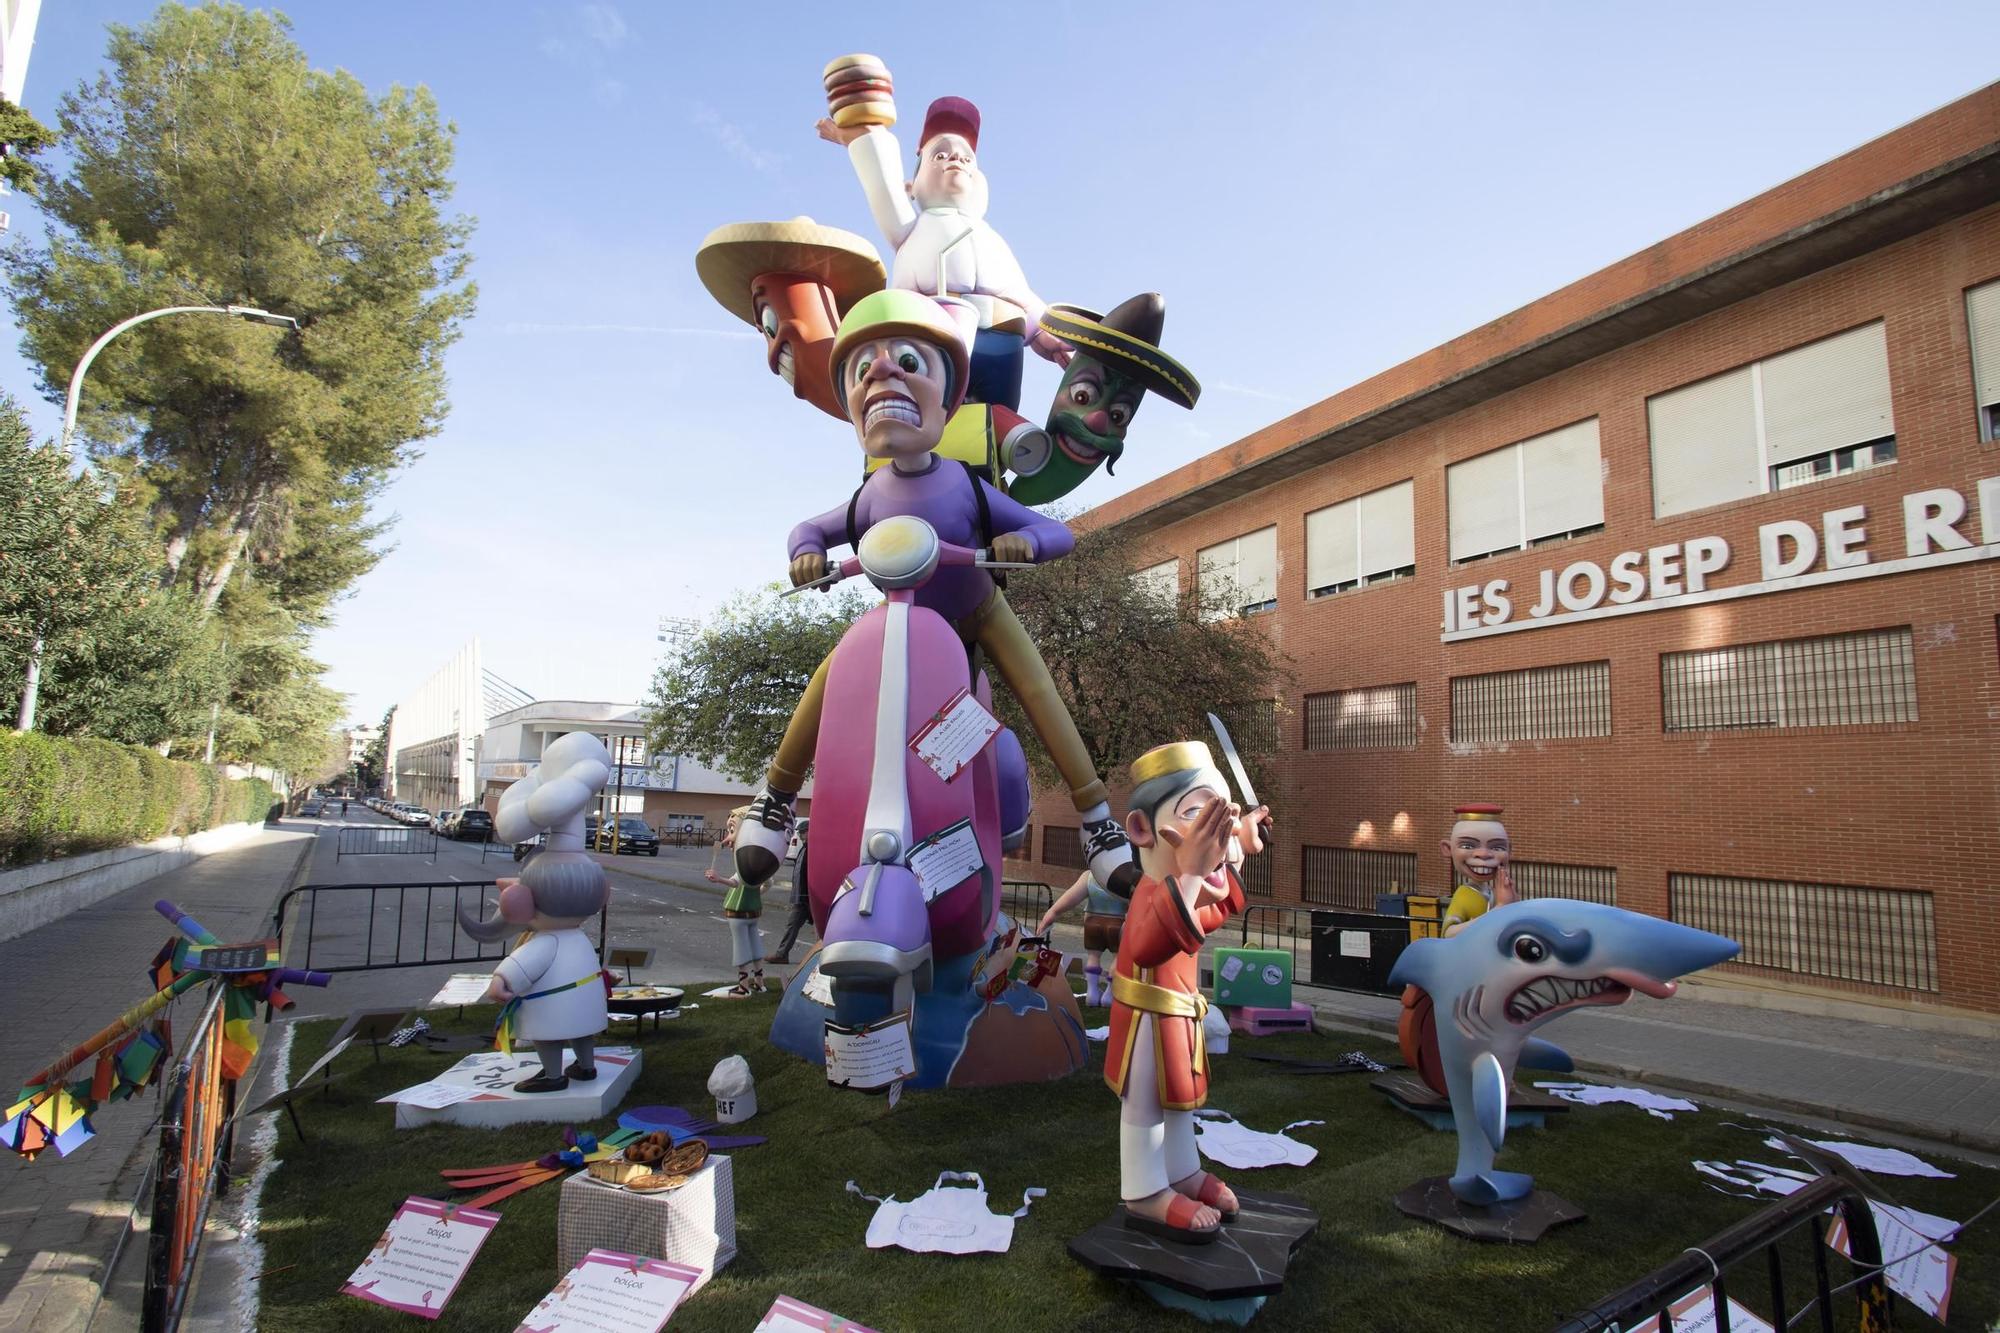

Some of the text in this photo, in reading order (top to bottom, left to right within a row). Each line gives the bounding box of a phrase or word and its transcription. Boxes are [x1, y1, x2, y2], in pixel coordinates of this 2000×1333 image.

[1444, 579, 1513, 632] IES
[1529, 535, 1731, 618] JOSEP
[1759, 505, 1870, 581] DE
[717, 1101, 735, 1115] HEF
[426, 1227, 453, 1240] DOLÇOS
[613, 1275, 646, 1289] DOLÇOS
